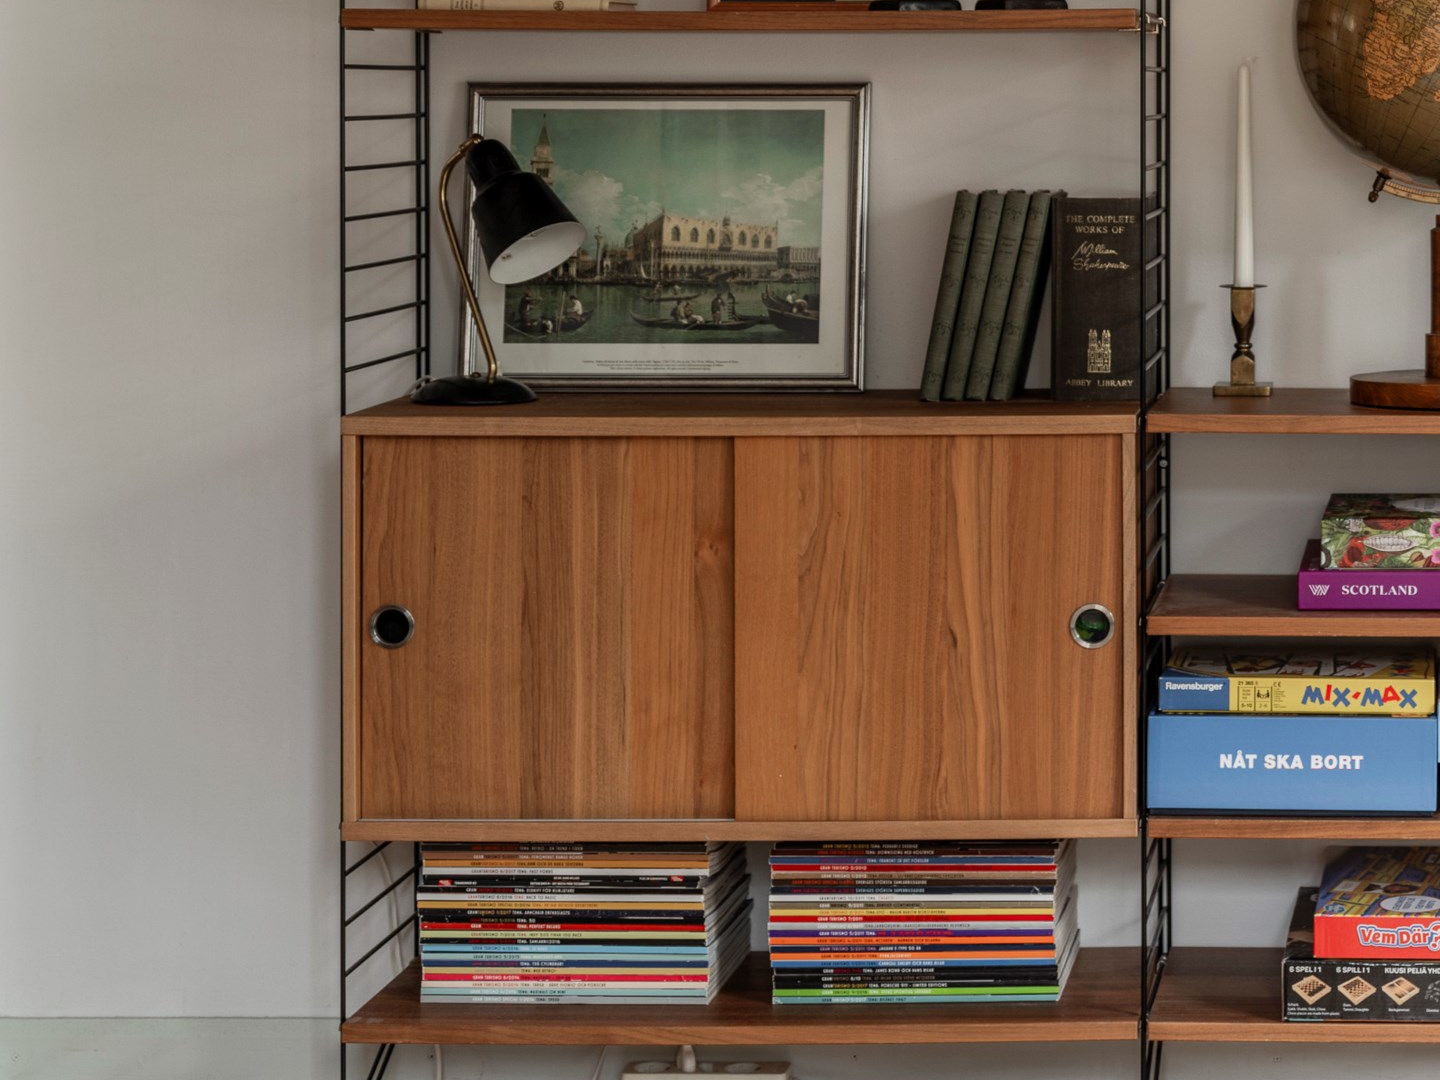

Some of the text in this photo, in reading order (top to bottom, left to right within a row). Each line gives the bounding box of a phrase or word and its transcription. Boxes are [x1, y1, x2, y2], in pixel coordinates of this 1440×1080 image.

[1067, 215, 1083, 223] THE
[1076, 226, 1107, 234] WORKS
[1071, 241, 1118, 259] William
[1341, 585, 1418, 596] SCOTLAND
[1165, 682, 1223, 691] Ravensburger
[1219, 750, 1364, 770] NÅT SKA BORT
[1358, 926, 1397, 946] Vem
